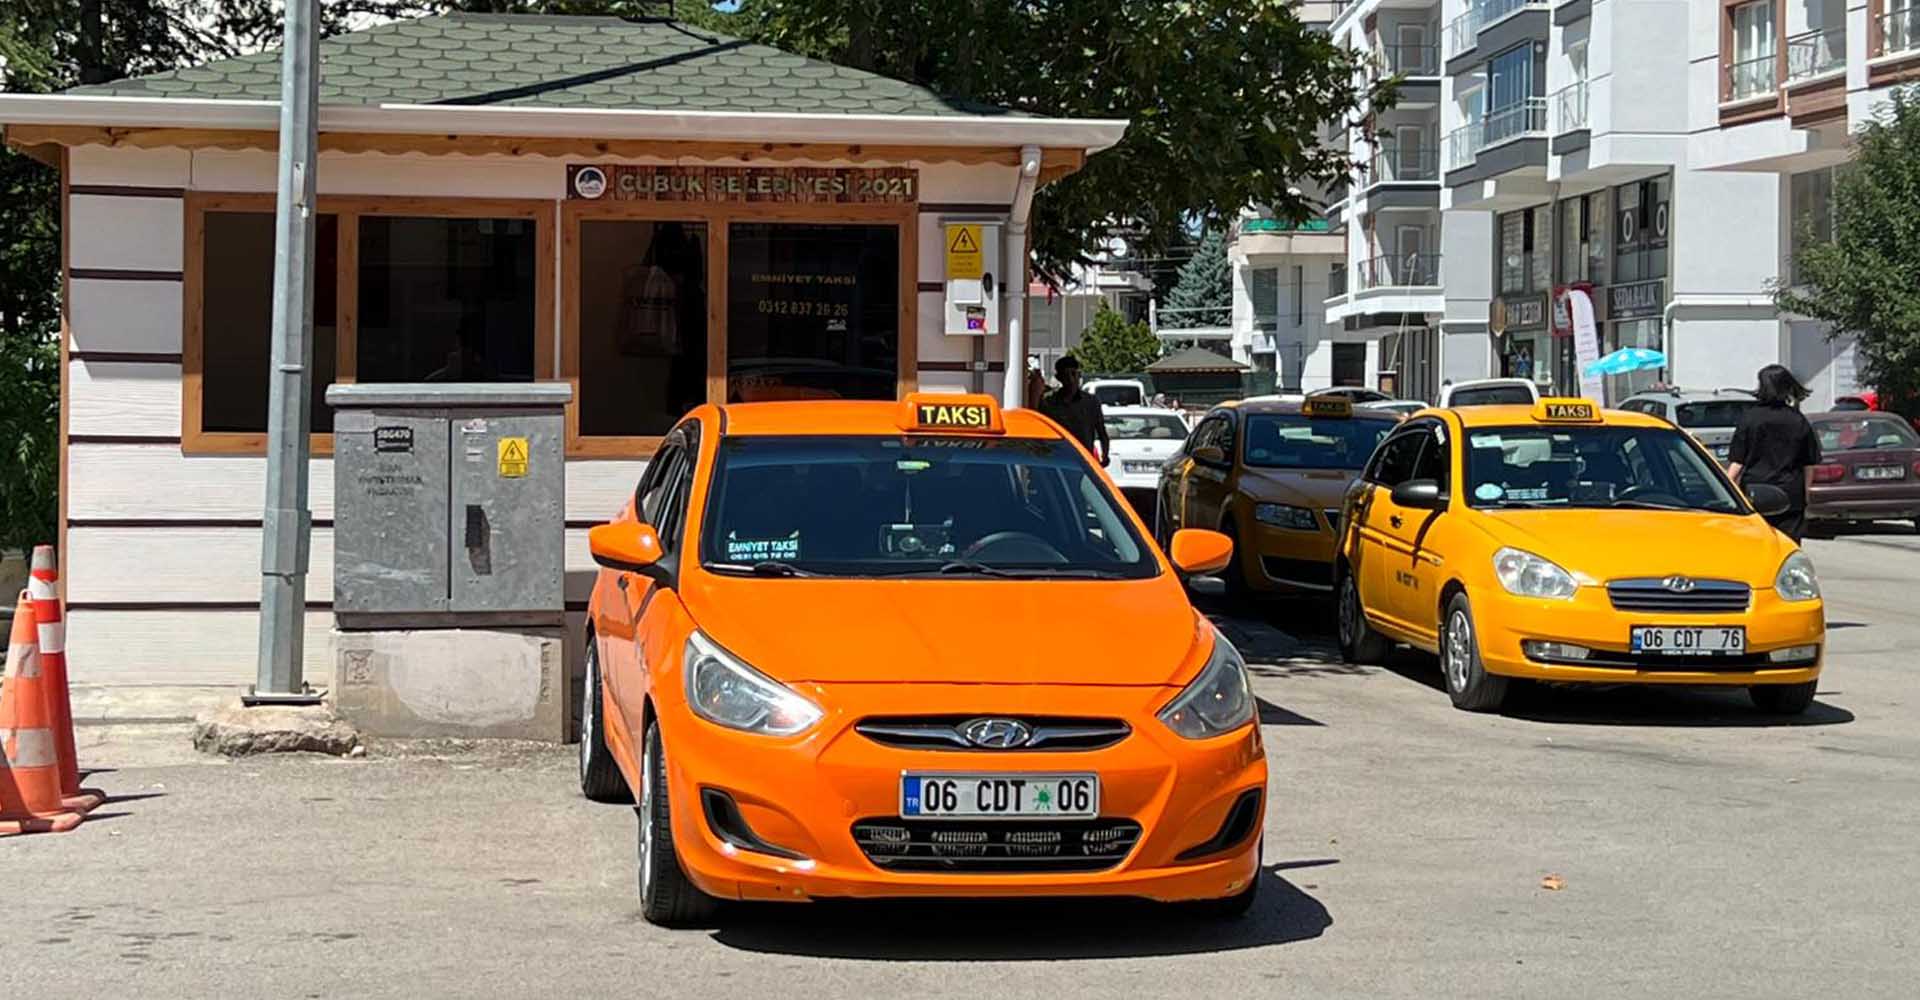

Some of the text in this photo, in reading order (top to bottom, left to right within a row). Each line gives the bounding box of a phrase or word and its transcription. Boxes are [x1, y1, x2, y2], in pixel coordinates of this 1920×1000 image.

[859, 177, 913, 195] 2021
[1644, 630, 1740, 649] 06 CDT 76
[906, 780, 1089, 811] TR 06 CDT 06
